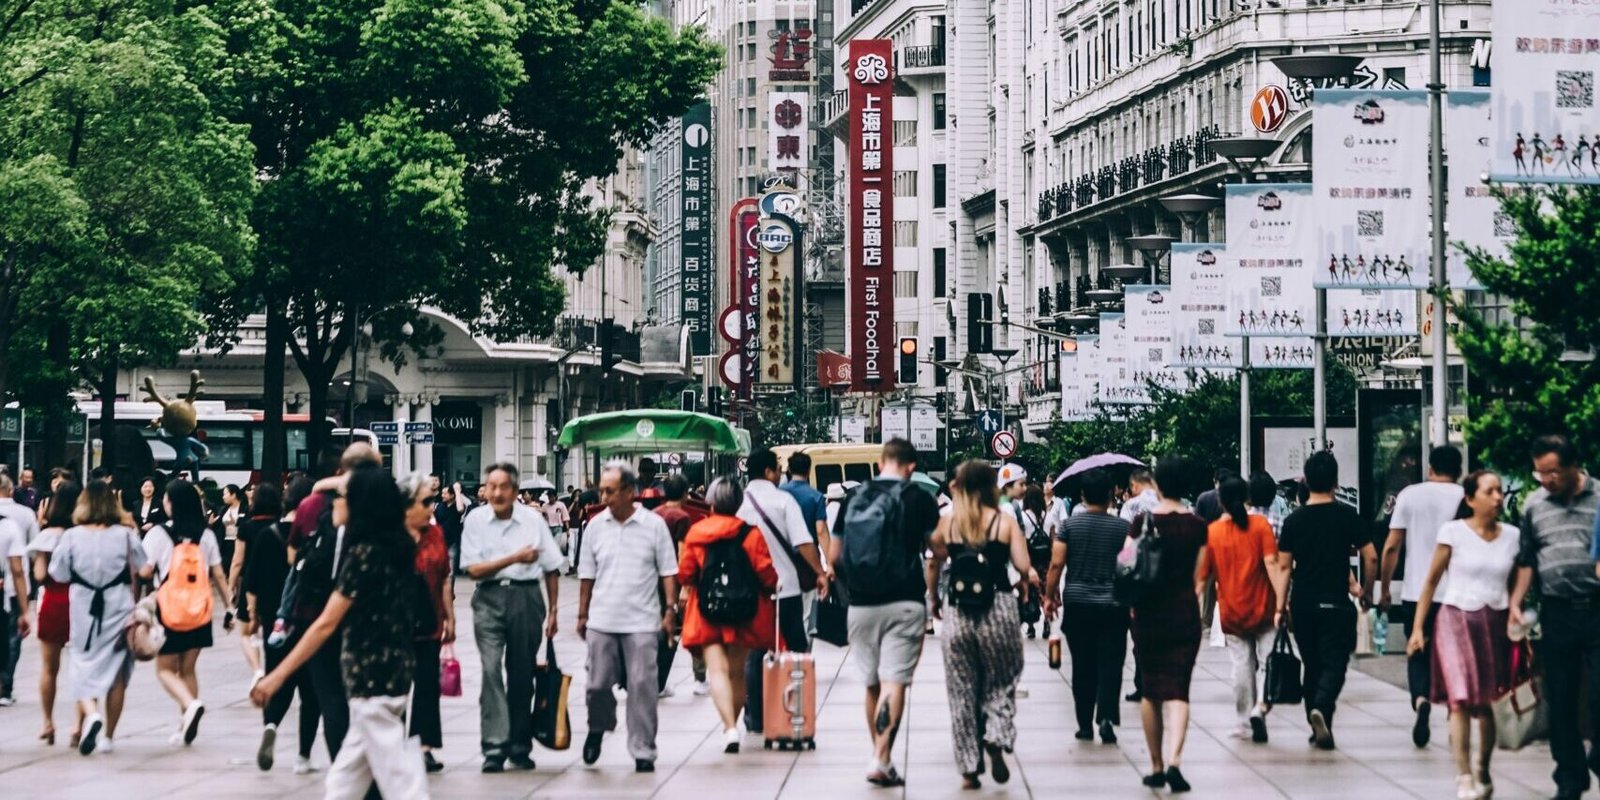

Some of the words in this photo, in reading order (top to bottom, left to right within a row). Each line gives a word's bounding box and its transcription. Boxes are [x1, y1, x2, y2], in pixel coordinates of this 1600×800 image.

[862, 93, 881, 266] 上海市第一食品商店
[685, 156, 700, 332] 上海市第一百货商店
[866, 277, 879, 307] First
[866, 311, 880, 378] Foodhall
